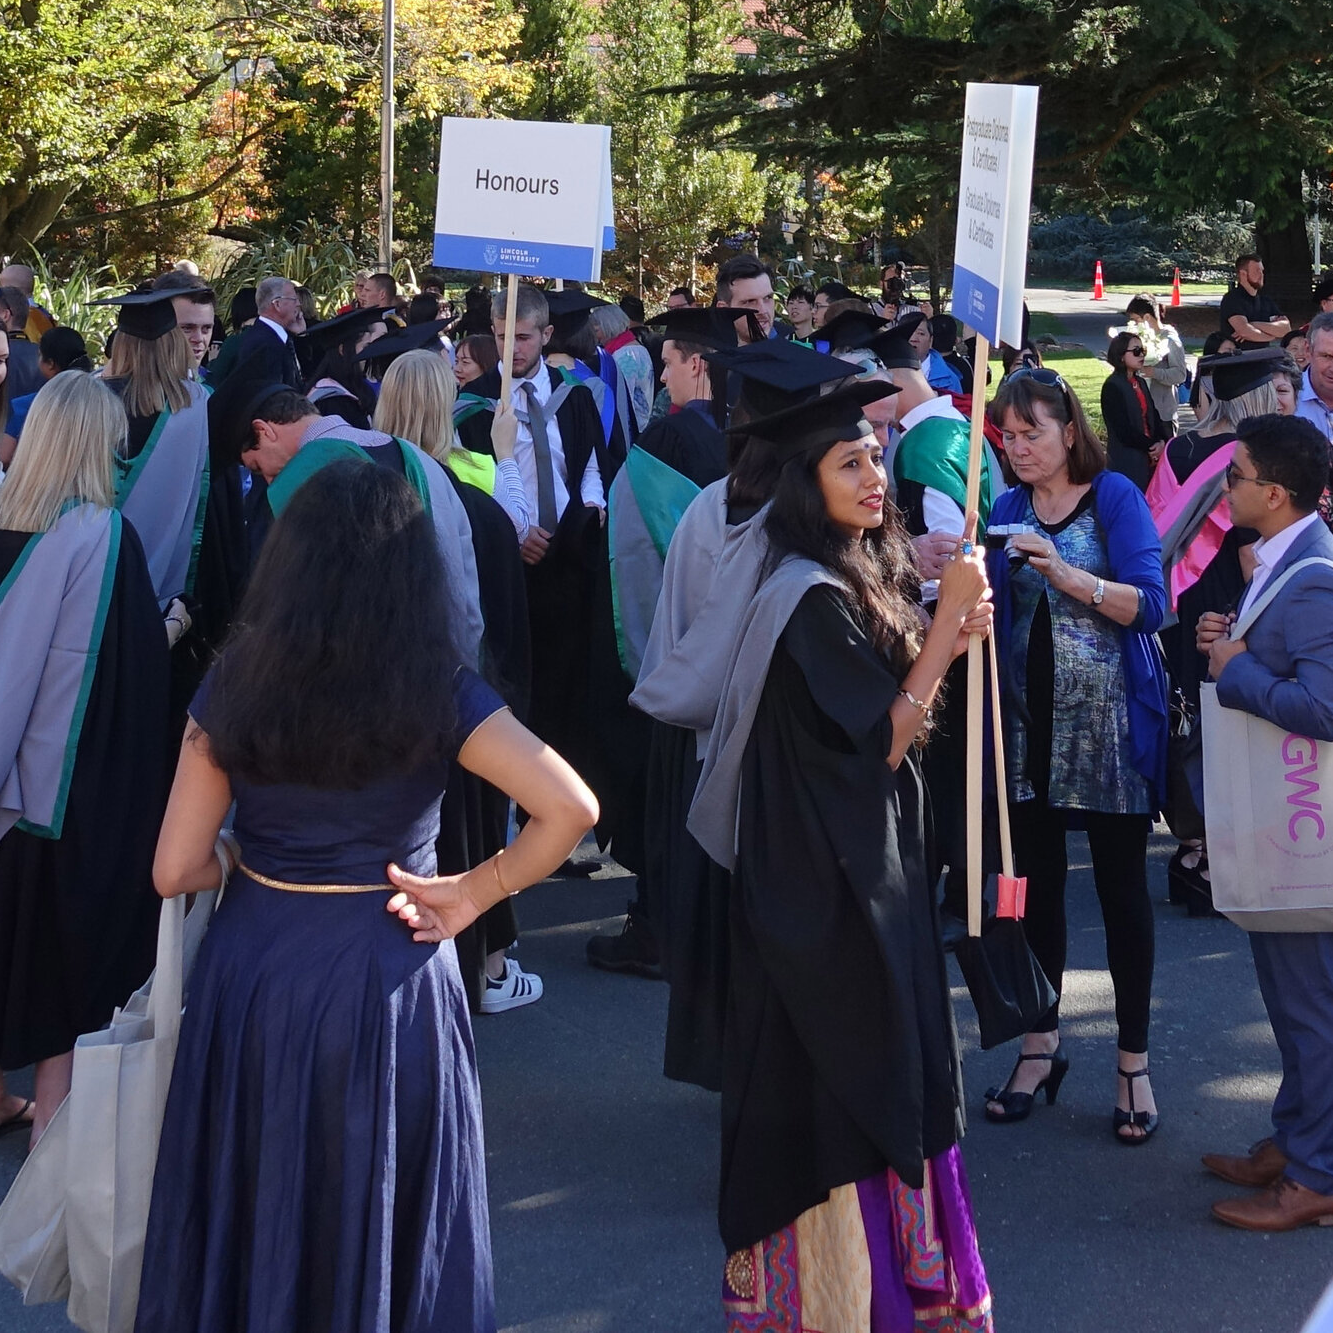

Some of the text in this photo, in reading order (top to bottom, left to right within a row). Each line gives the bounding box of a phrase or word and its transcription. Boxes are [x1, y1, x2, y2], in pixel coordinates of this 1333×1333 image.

[966, 115, 1009, 145] Postgraduate Diplomas
[976, 147, 998, 173] Certificates
[475, 168, 559, 195] Honours
[965, 187, 1001, 218] Graduate Diplomas
[972, 219, 994, 249] Certificates
[500, 247, 529, 256] LINCOLN
[500, 254, 540, 263] UNIVERSITY
[1281, 733, 1325, 842] GWC
